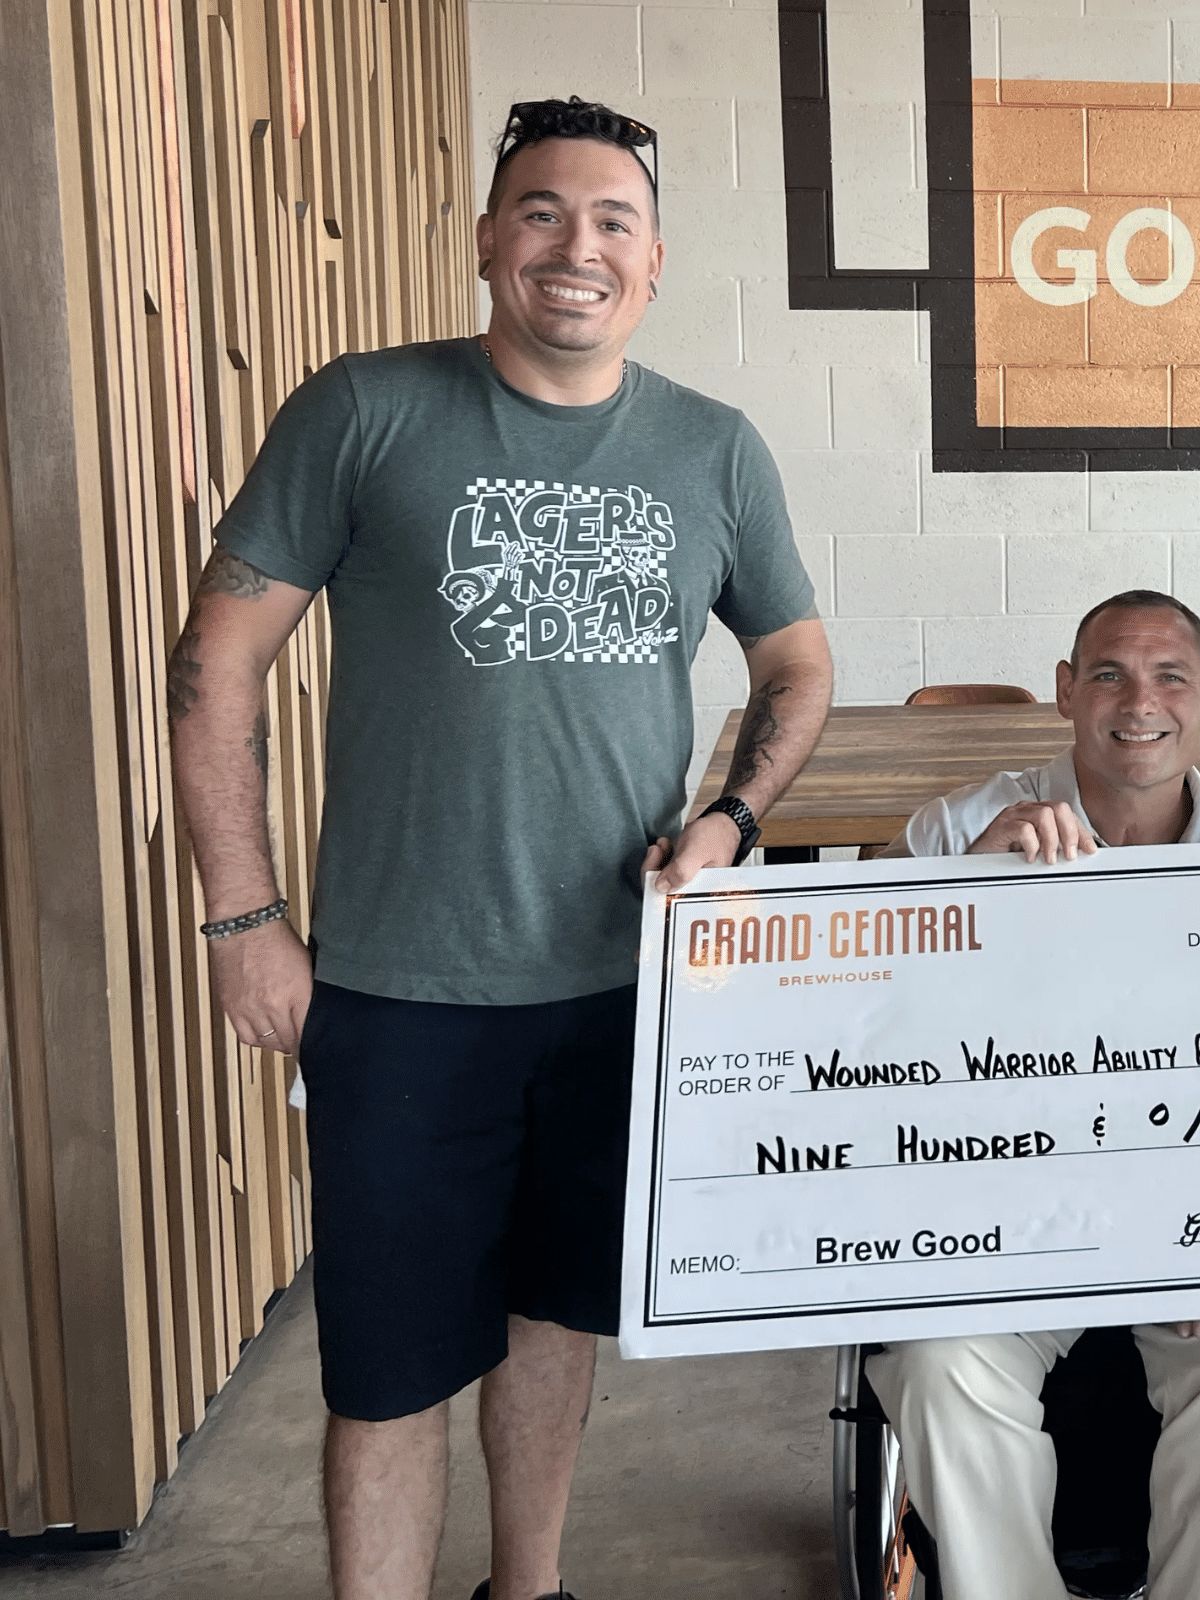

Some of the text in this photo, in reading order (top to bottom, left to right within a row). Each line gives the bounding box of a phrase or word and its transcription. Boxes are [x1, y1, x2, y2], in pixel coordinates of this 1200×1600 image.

[448, 485, 676, 571] LAGER'S
[526, 585, 669, 661] DEAD
[688, 904, 982, 968] GRAND CENTRAL
[779, 971, 893, 987] BREWHOUSE
[679, 1075, 785, 1096] ORDER OF
[680, 1050, 795, 1073] PAY TO THE
[805, 1049, 941, 1091] WOUNDED
[961, 1037, 1075, 1081] WARRIOR
[1093, 1035, 1178, 1073] ABILITY
[756, 1136, 855, 1175] NINE
[897, 1125, 1056, 1164] HUNDRED
[670, 1226, 1002, 1275] MEMO: Brew Good
